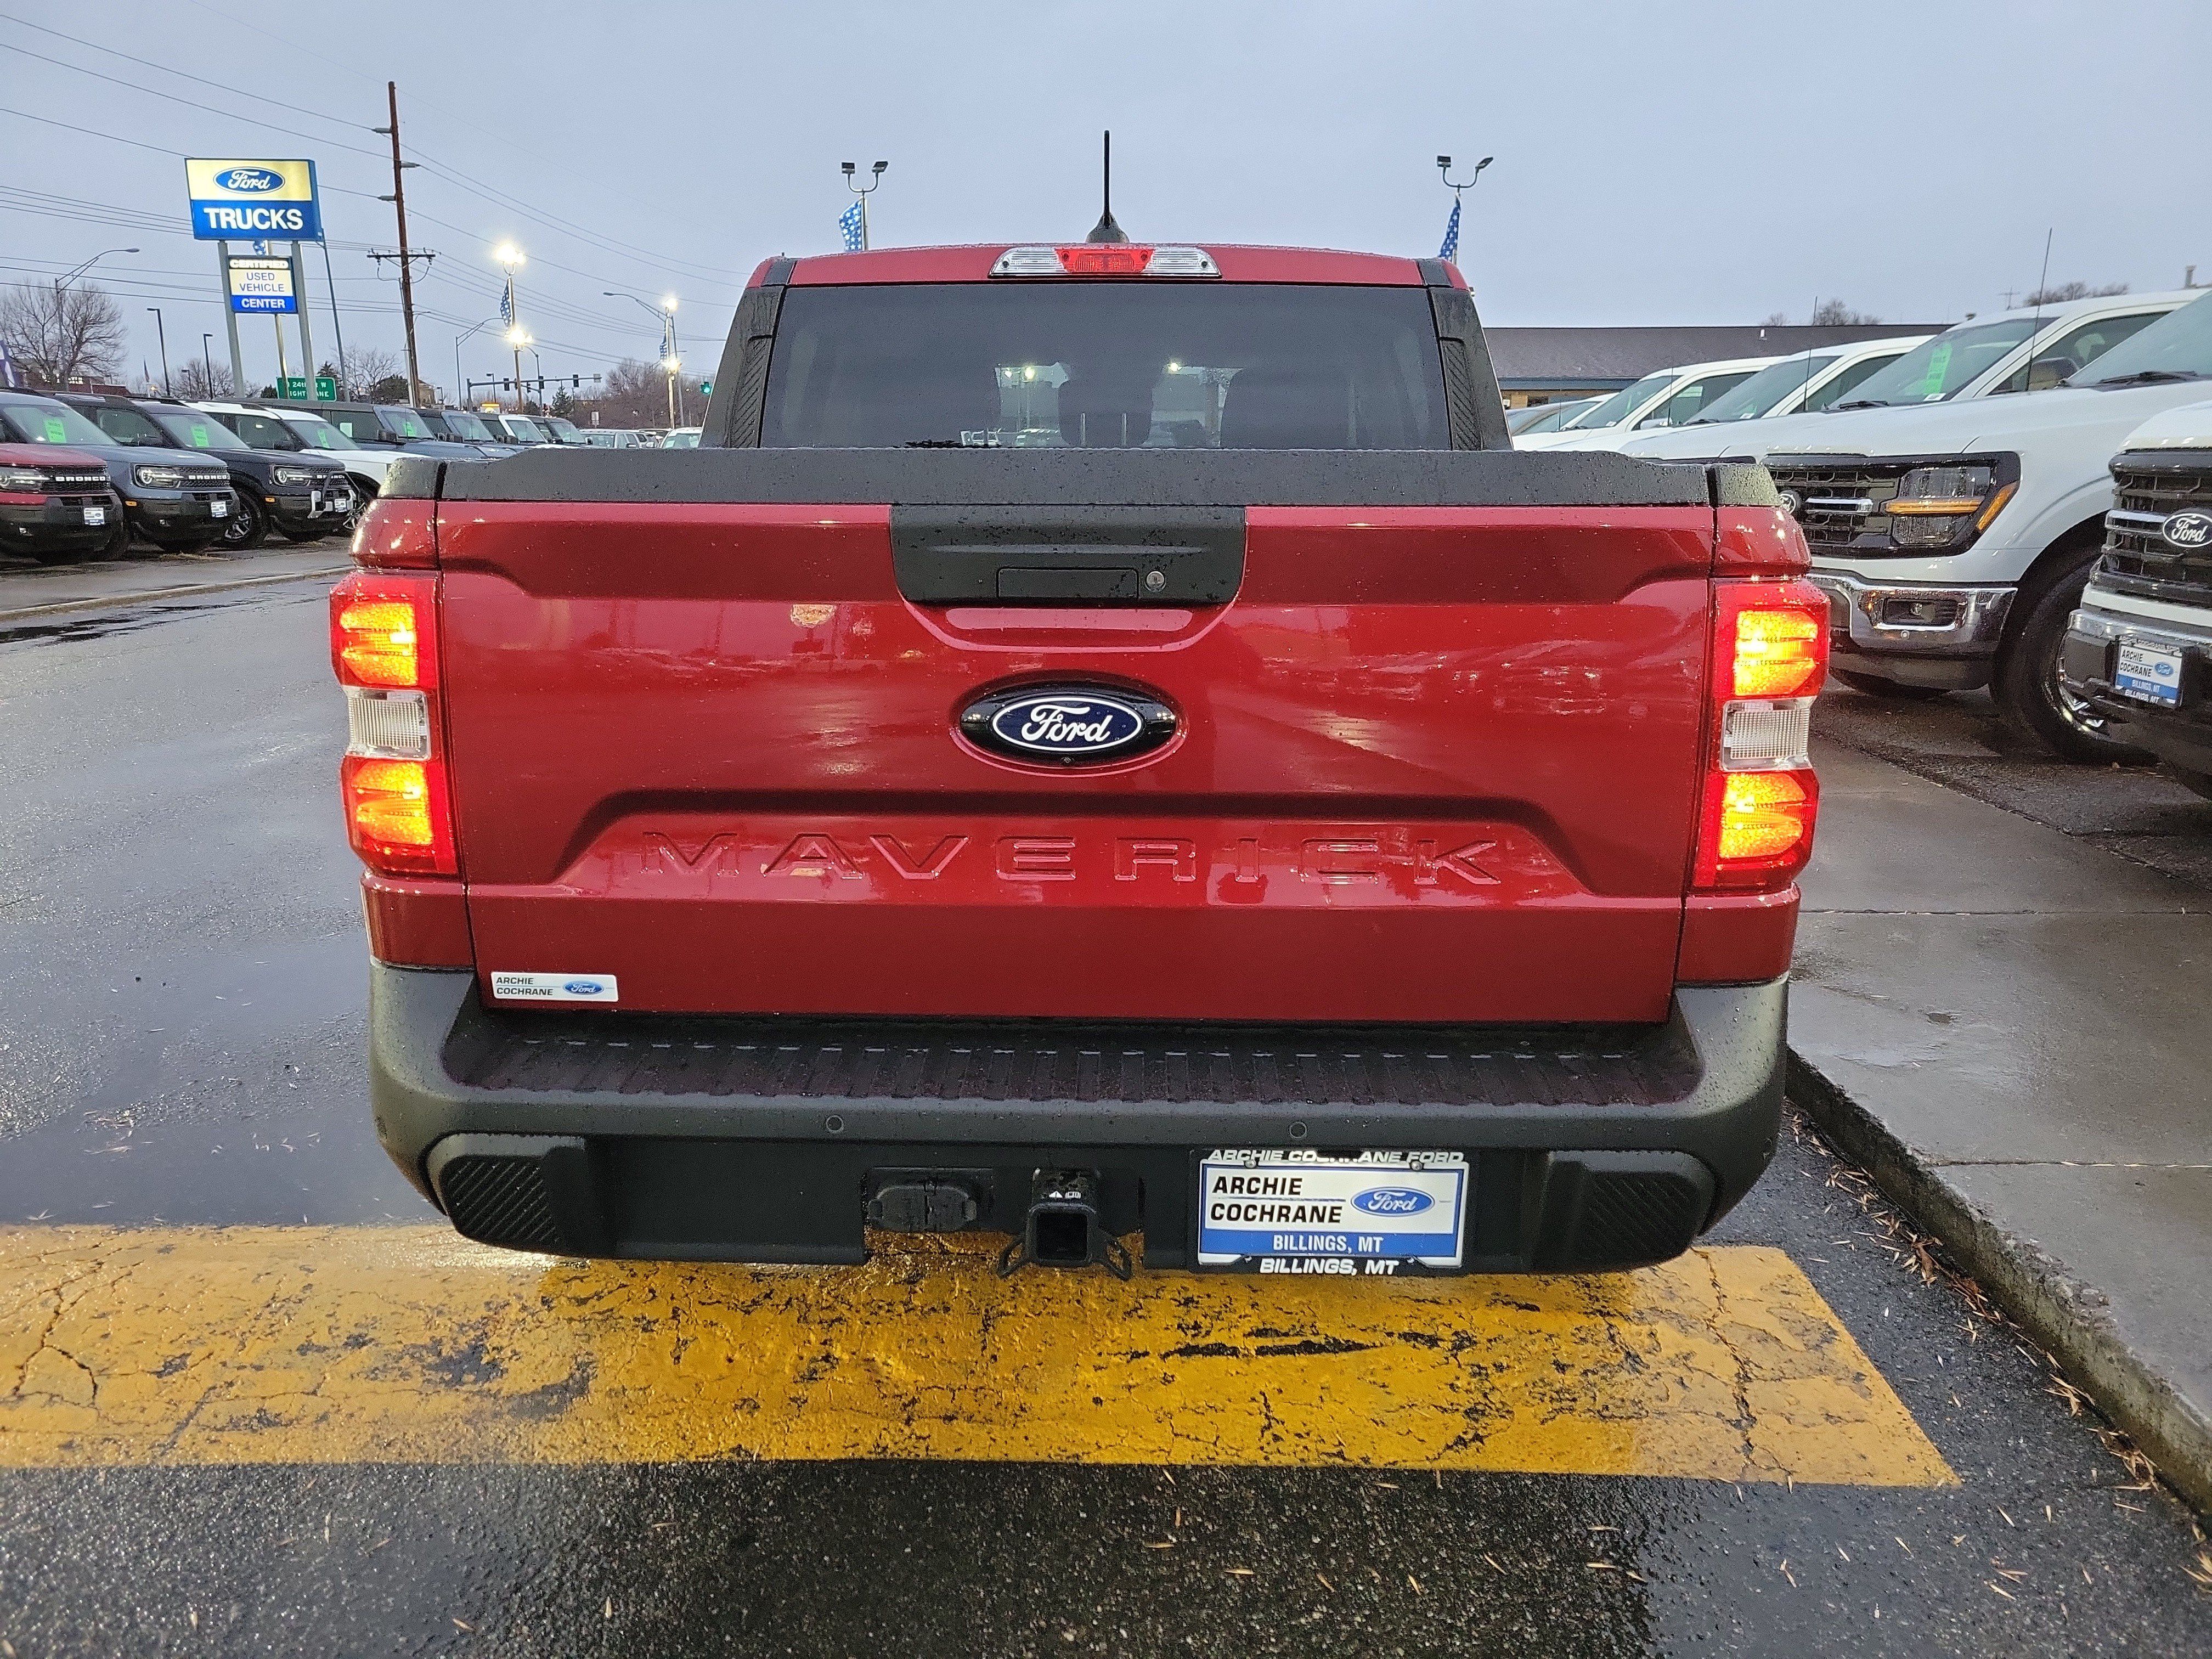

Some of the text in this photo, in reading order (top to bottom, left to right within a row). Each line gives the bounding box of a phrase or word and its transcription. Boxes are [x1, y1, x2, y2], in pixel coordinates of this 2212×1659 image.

[227, 170, 270, 190] Ford
[203, 207, 303, 230] TRUCKS
[229, 259, 289, 269] CERTIFIED
[246, 272, 275, 281] USED
[239, 283, 285, 292] VEHICLE
[241, 298, 286, 309] CENTER
[2171, 517, 2209, 543] Ford
[2121, 649, 2143, 662] ARCHIE
[2119, 662, 2152, 678] COCHRANE
[1020, 704, 1114, 742] Ford
[641, 831, 1502, 885] MAVERICK
[496, 977, 534, 985] ARCHIE
[571, 983, 597, 994] Ford
[496, 987, 554, 996] COCHRANE
[1207, 1149, 1465, 1164] ARCHIE COANE FORD
[1212, 1176, 1303, 1196] ARCHIE
[1367, 1190, 1418, 1211] Ford
[1210, 1203, 1342, 1223] COCHRANE
[1273, 1234, 1384, 1254] BILLINGS, MT
[1260, 1258, 1400, 1276] BILLINGS, MT
